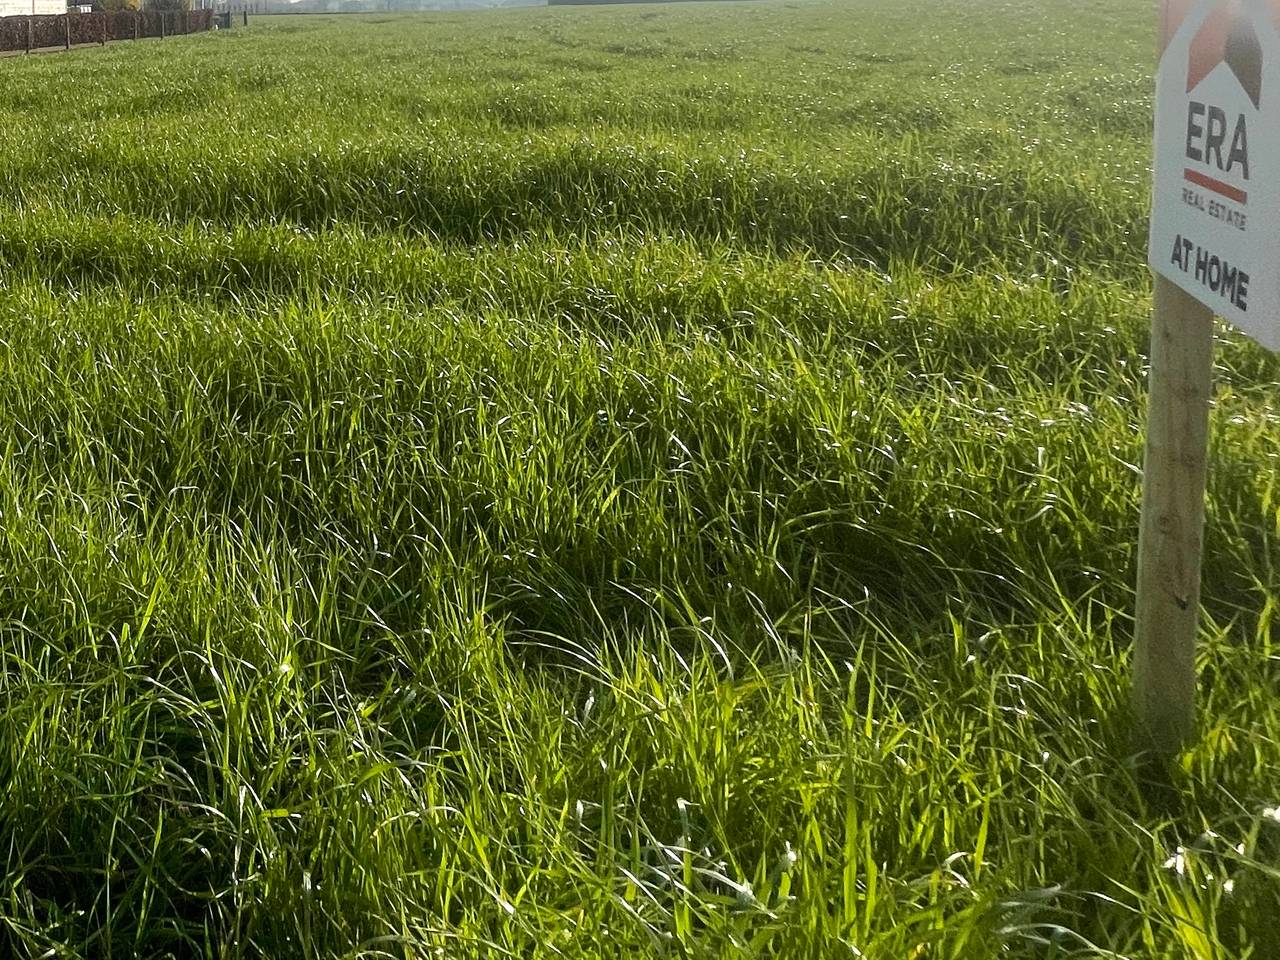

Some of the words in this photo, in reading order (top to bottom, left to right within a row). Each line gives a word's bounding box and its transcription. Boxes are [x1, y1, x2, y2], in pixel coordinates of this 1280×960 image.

[1186, 101, 1249, 180] ERA
[1182, 187, 1205, 212] REAL
[1208, 198, 1247, 231] ESTATE
[1171, 234, 1194, 272] AT
[1195, 246, 1250, 311] HOME
